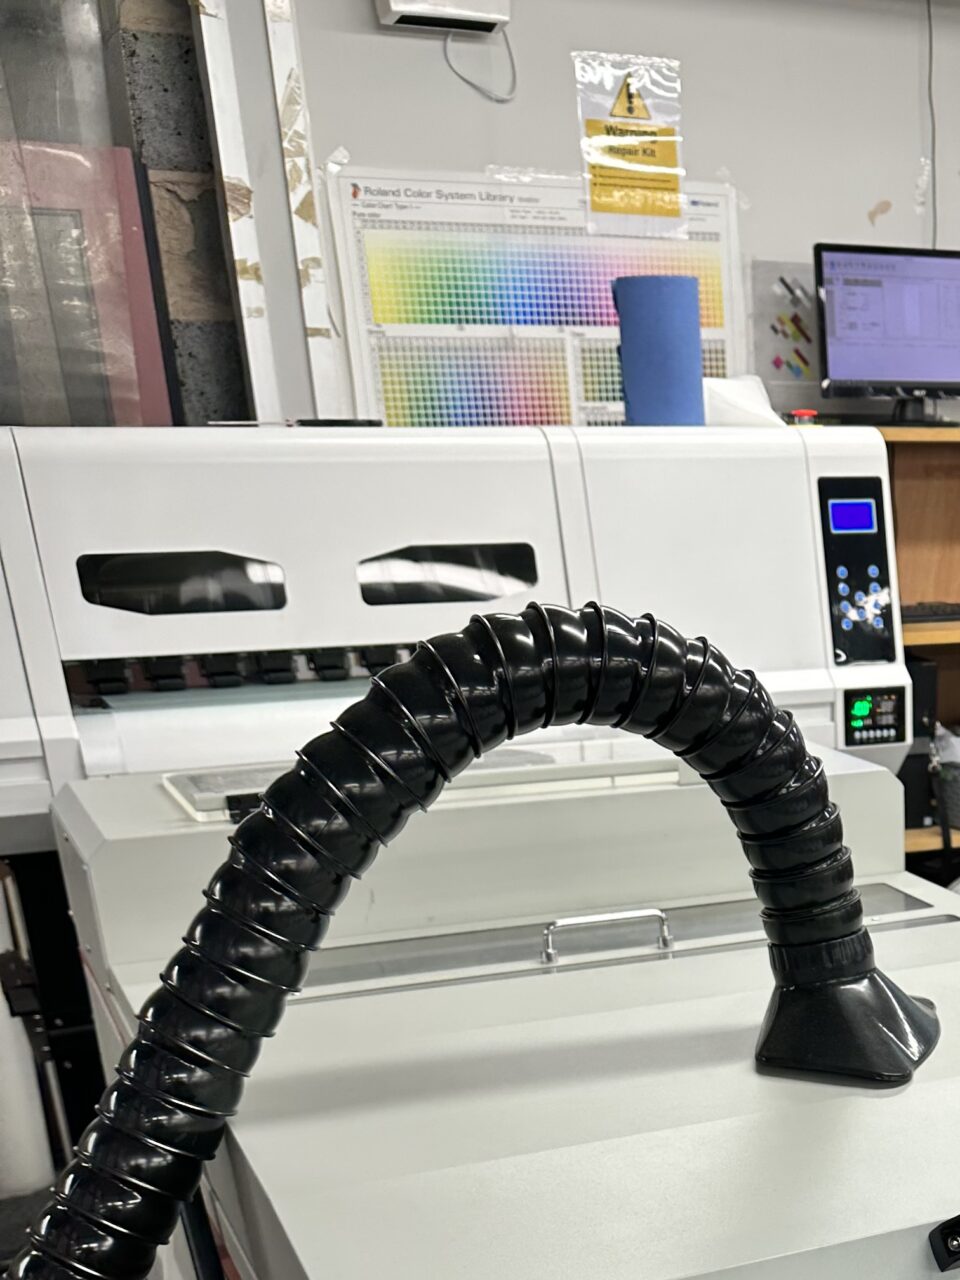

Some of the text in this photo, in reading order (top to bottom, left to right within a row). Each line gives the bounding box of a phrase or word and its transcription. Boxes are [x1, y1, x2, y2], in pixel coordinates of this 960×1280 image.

[641, 147, 657, 158] Kit
[363, 185, 401, 198] Roland
[404, 187, 432, 199] Color
[435, 188, 476, 201] System
[478, 190, 515, 204] Library
